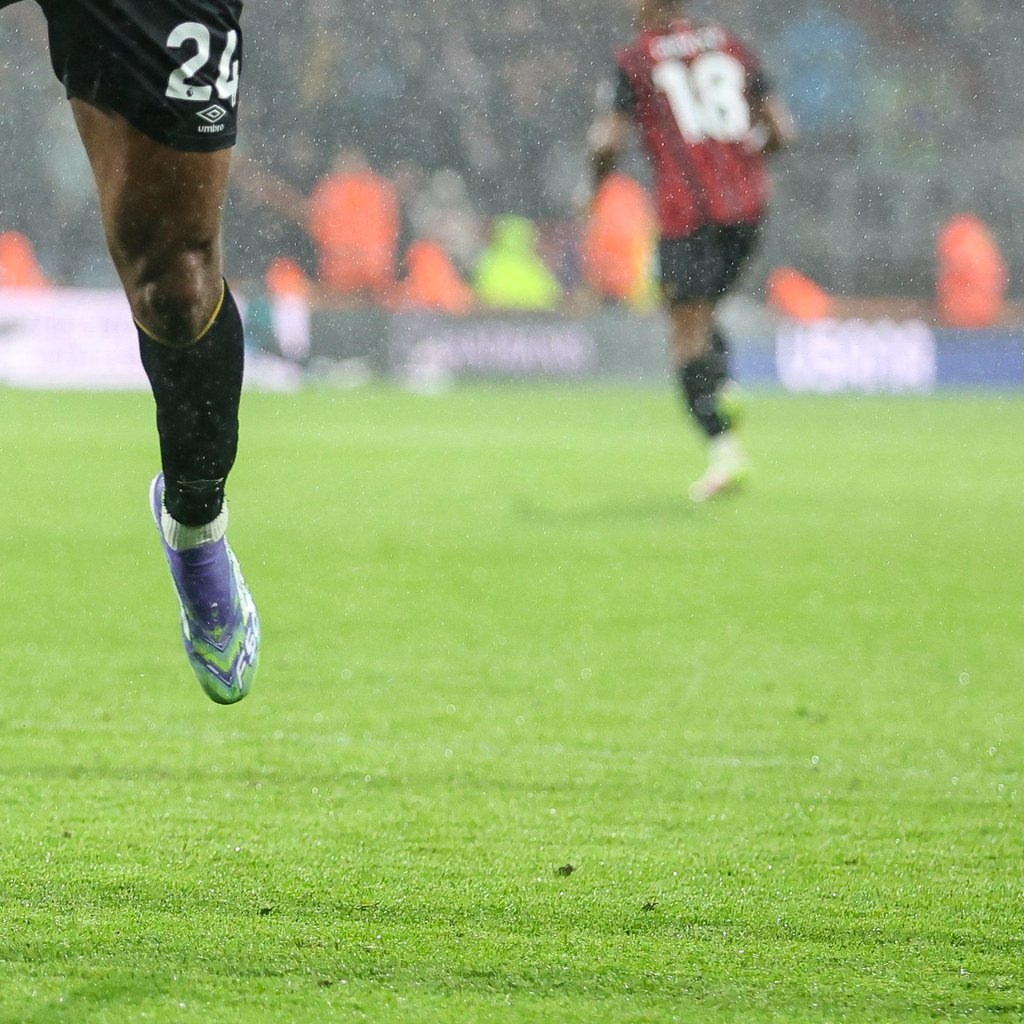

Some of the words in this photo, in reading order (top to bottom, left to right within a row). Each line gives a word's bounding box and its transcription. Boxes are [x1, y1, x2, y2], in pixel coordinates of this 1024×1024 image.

[165, 21, 239, 108] 24
[651, 50, 751, 145] 18
[198, 123, 224, 133] umbro
